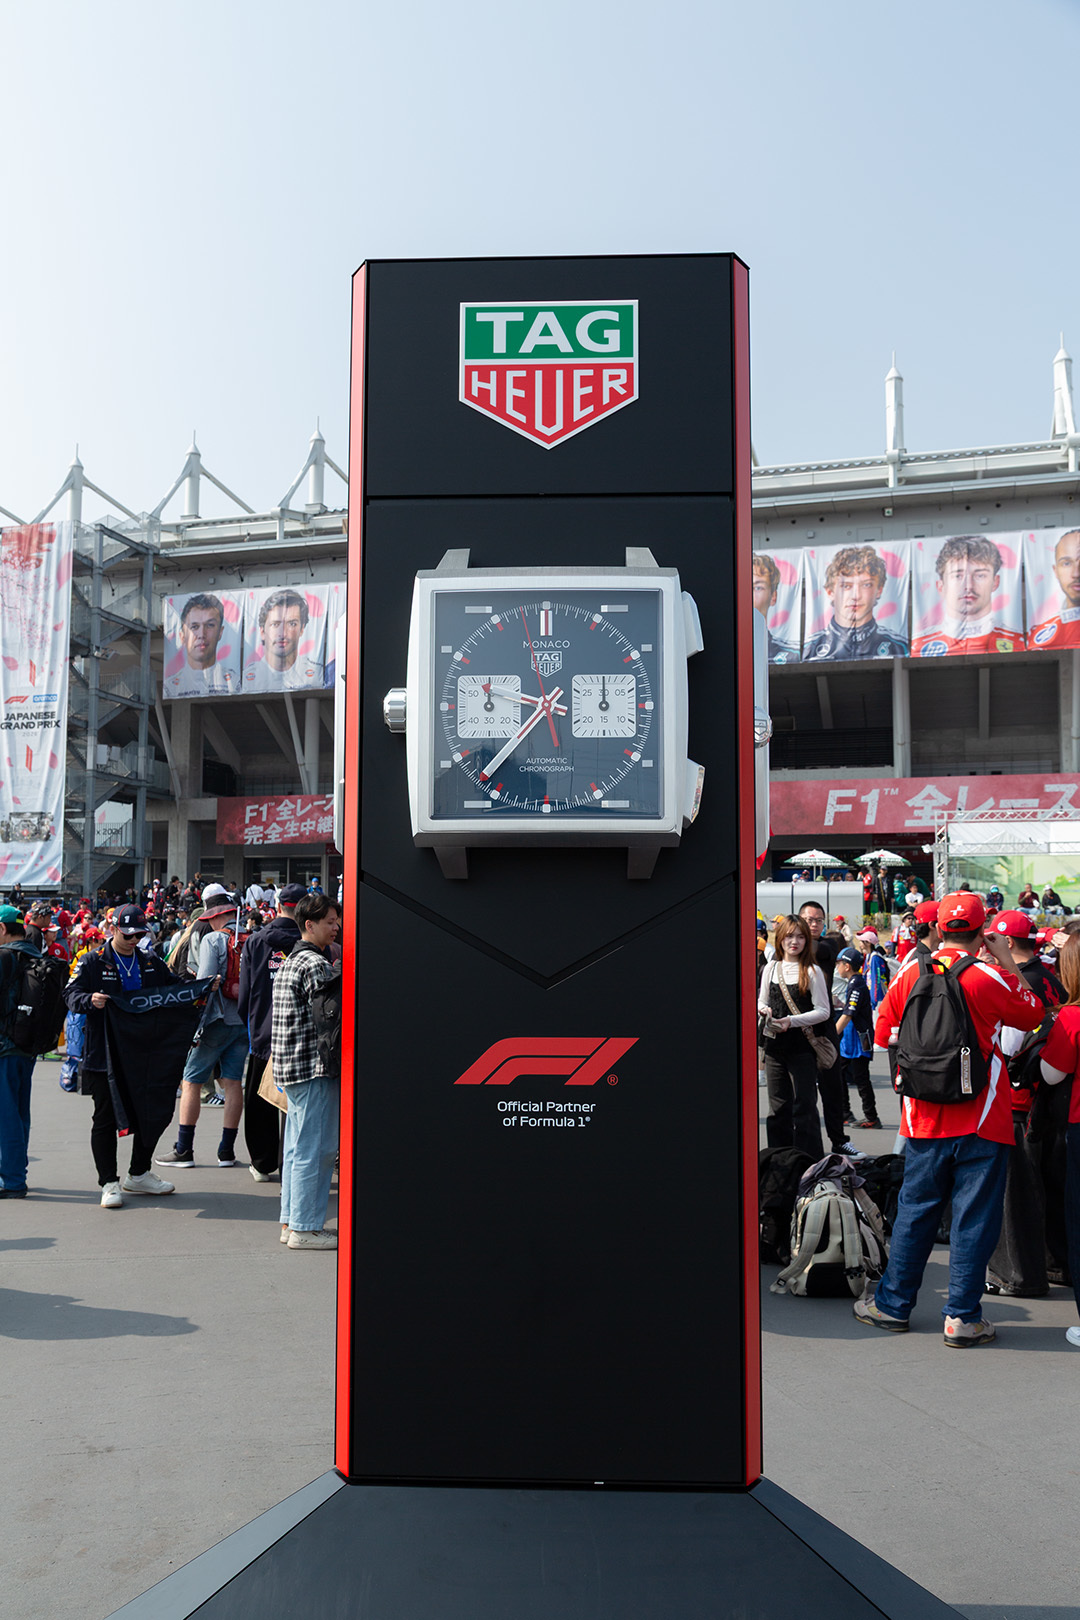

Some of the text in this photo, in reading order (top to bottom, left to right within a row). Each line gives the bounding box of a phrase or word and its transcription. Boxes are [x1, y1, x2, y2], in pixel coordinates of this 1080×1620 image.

[476, 310, 621, 354] TAG
[471, 368, 628, 437] HEUER
[522, 640, 571, 649] MONACO
[533, 653, 560, 661] TAG
[468, 689, 479, 698] 50
[582, 688, 626, 697] 25 30 05
[4, 711, 57, 721] JAPANESE
[467, 716, 512, 725] 40 30 20
[582, 715, 627, 724] 20 15 10
[0, 719, 61, 730] GRAND PRIX
[525, 757, 568, 765] AUTOMATIC
[518, 765, 576, 773] CHRONOGRAPH
[497, 1101, 596, 1112] Official Partner
[502, 1115, 517, 1127] of
[520, 1116, 575, 1127] Formula
